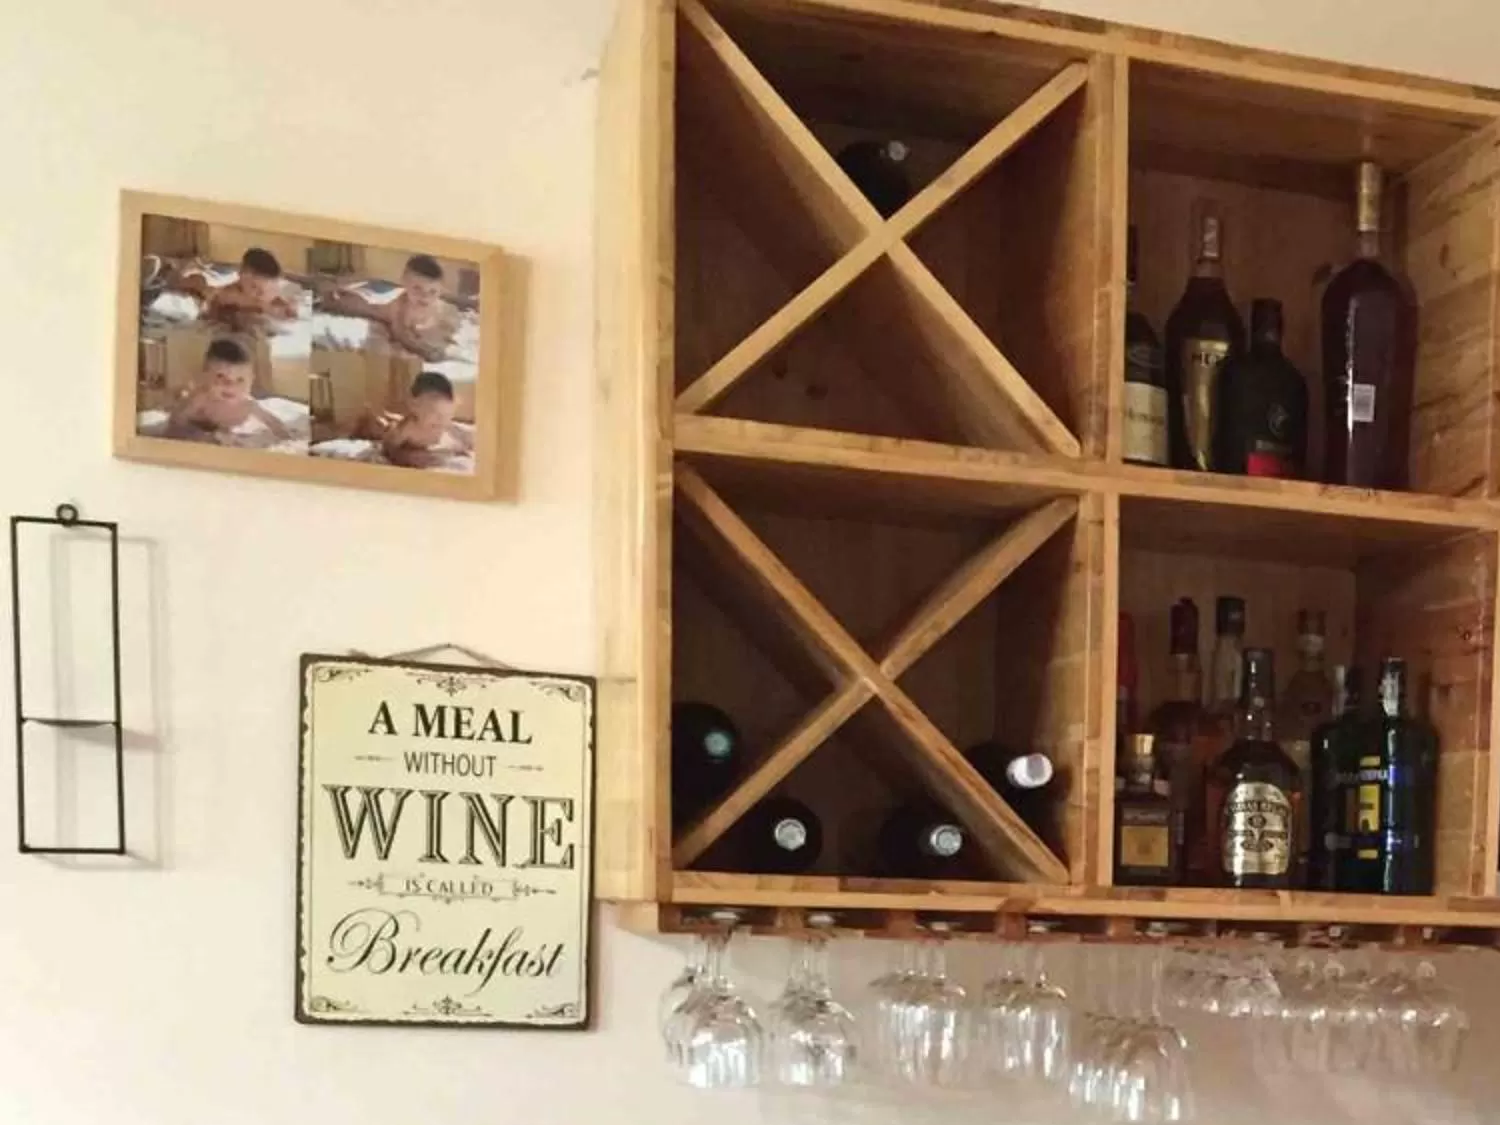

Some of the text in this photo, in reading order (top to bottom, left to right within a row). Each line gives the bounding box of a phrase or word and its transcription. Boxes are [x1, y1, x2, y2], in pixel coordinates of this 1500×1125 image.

[368, 700, 533, 745] A MEAL
[403, 751, 497, 777] WITHOUT
[322, 783, 575, 870] WINE
[404, 879, 494, 896] IS CALLED
[327, 907, 564, 998] Breakfast
